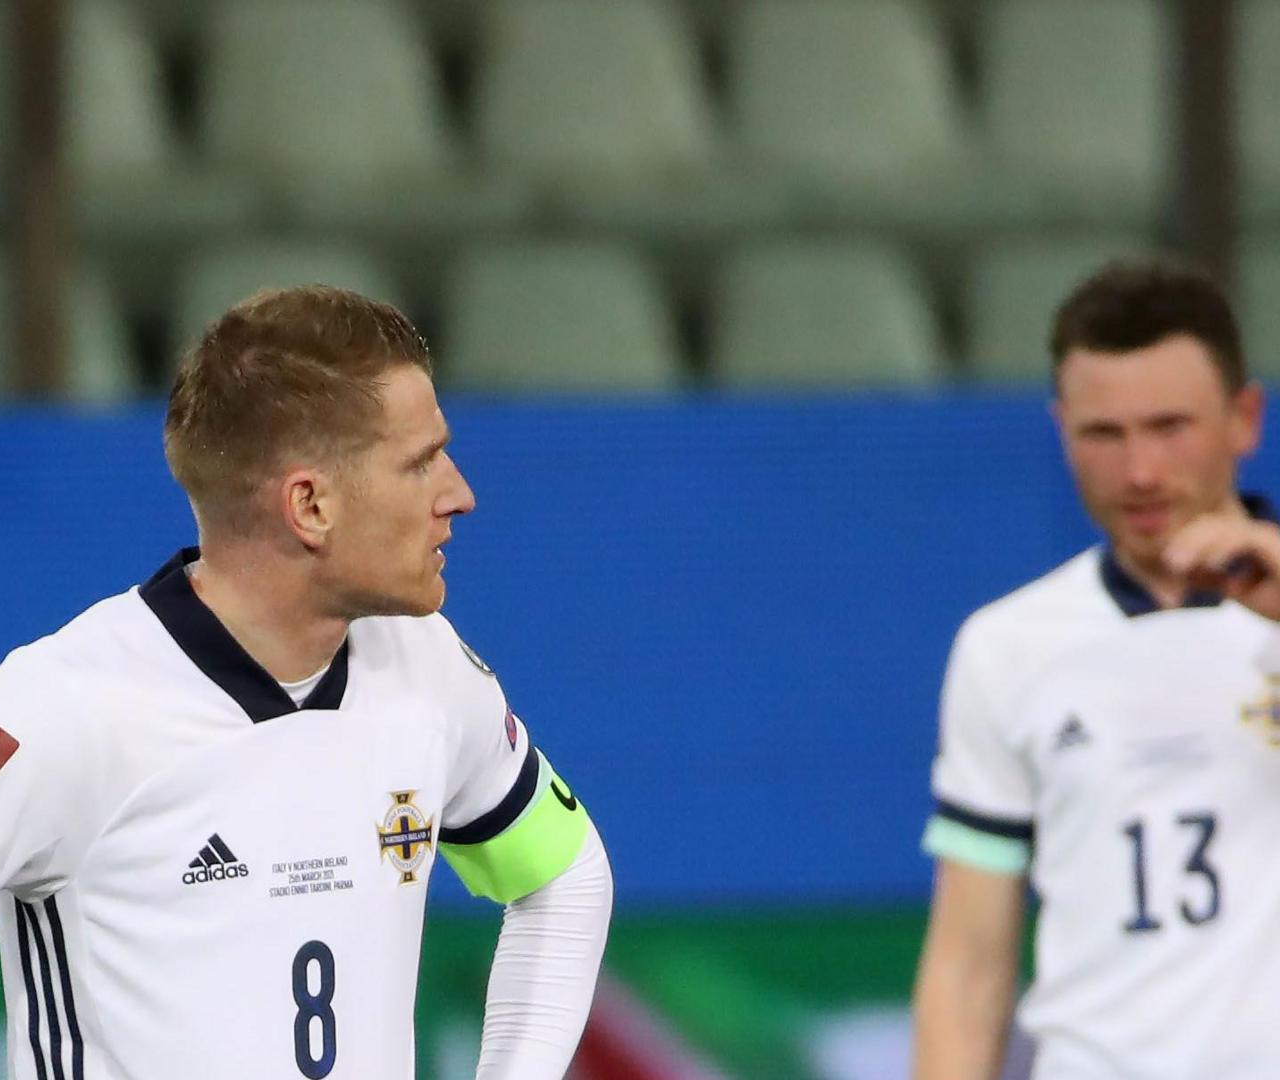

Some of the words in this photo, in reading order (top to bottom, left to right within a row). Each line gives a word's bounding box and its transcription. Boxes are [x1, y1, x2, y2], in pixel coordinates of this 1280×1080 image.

[182, 862, 249, 885] adidas
[272, 863, 286, 873] ITALY
[293, 859, 323, 871] NORTHERN
[324, 856, 348, 868] IRELAND
[1120, 813, 1221, 933] 13
[301, 871, 322, 881] MARCH
[269, 886, 290, 898] STADIO
[333, 880, 354, 889] PARMA
[292, 940, 336, 1080] 8
